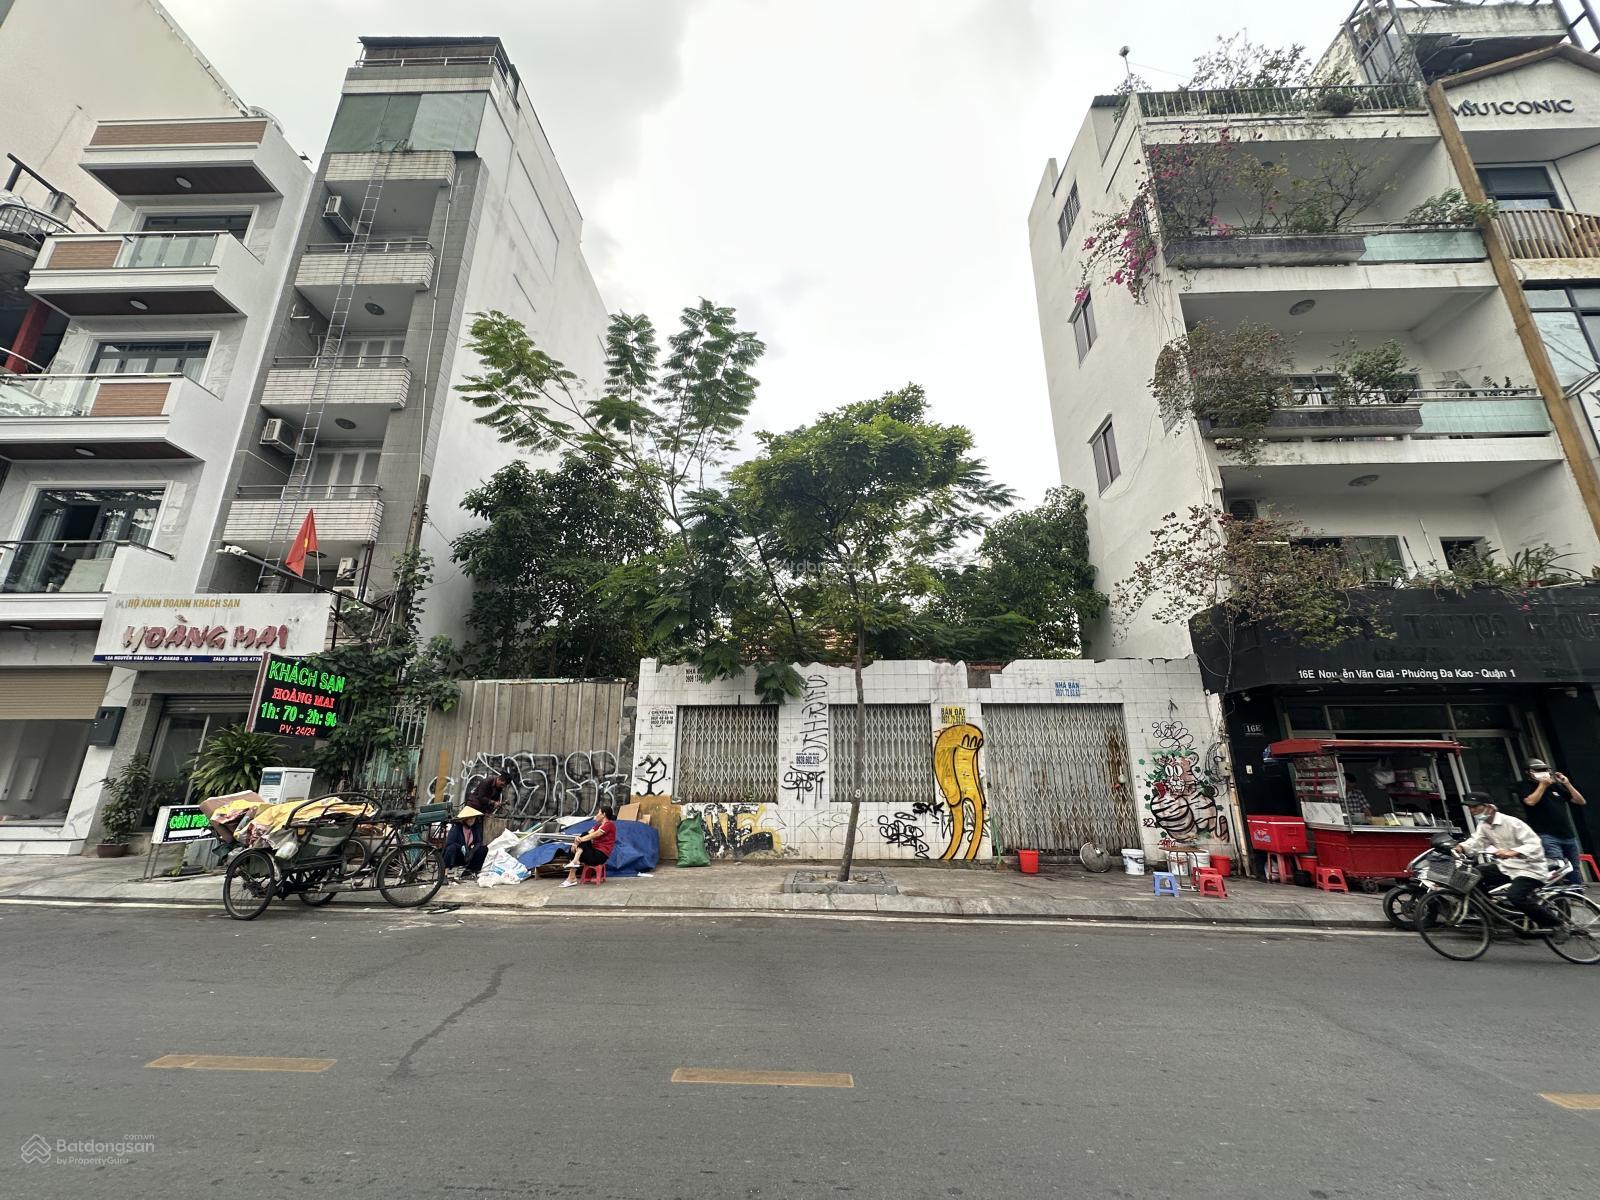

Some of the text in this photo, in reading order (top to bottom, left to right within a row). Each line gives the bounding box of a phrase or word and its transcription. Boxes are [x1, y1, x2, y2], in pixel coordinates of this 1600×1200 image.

[163, 598, 191, 608] DOANH
[232, 624, 289, 650] MAI
[269, 661, 346, 694] KHÁCH SẠN
[1298, 669, 1316, 679] 16E
[1318, 668, 1355, 680] Nguễn
[1355, 669, 1374, 678] Văn
[1375, 669, 1395, 678] Giai
[1401, 668, 1439, 680] Phường
[1440, 669, 1453, 678] Đa
[1454, 669, 1474, 678] Kao
[1481, 668, 1507, 680] Quận
[1509, 669, 1516, 677] 1
[314, 695, 335, 708] MAI
[282, 705, 298, 722] 70
[1246, 724, 1262, 732] 16E
[854, 788, 861, 799] 8
